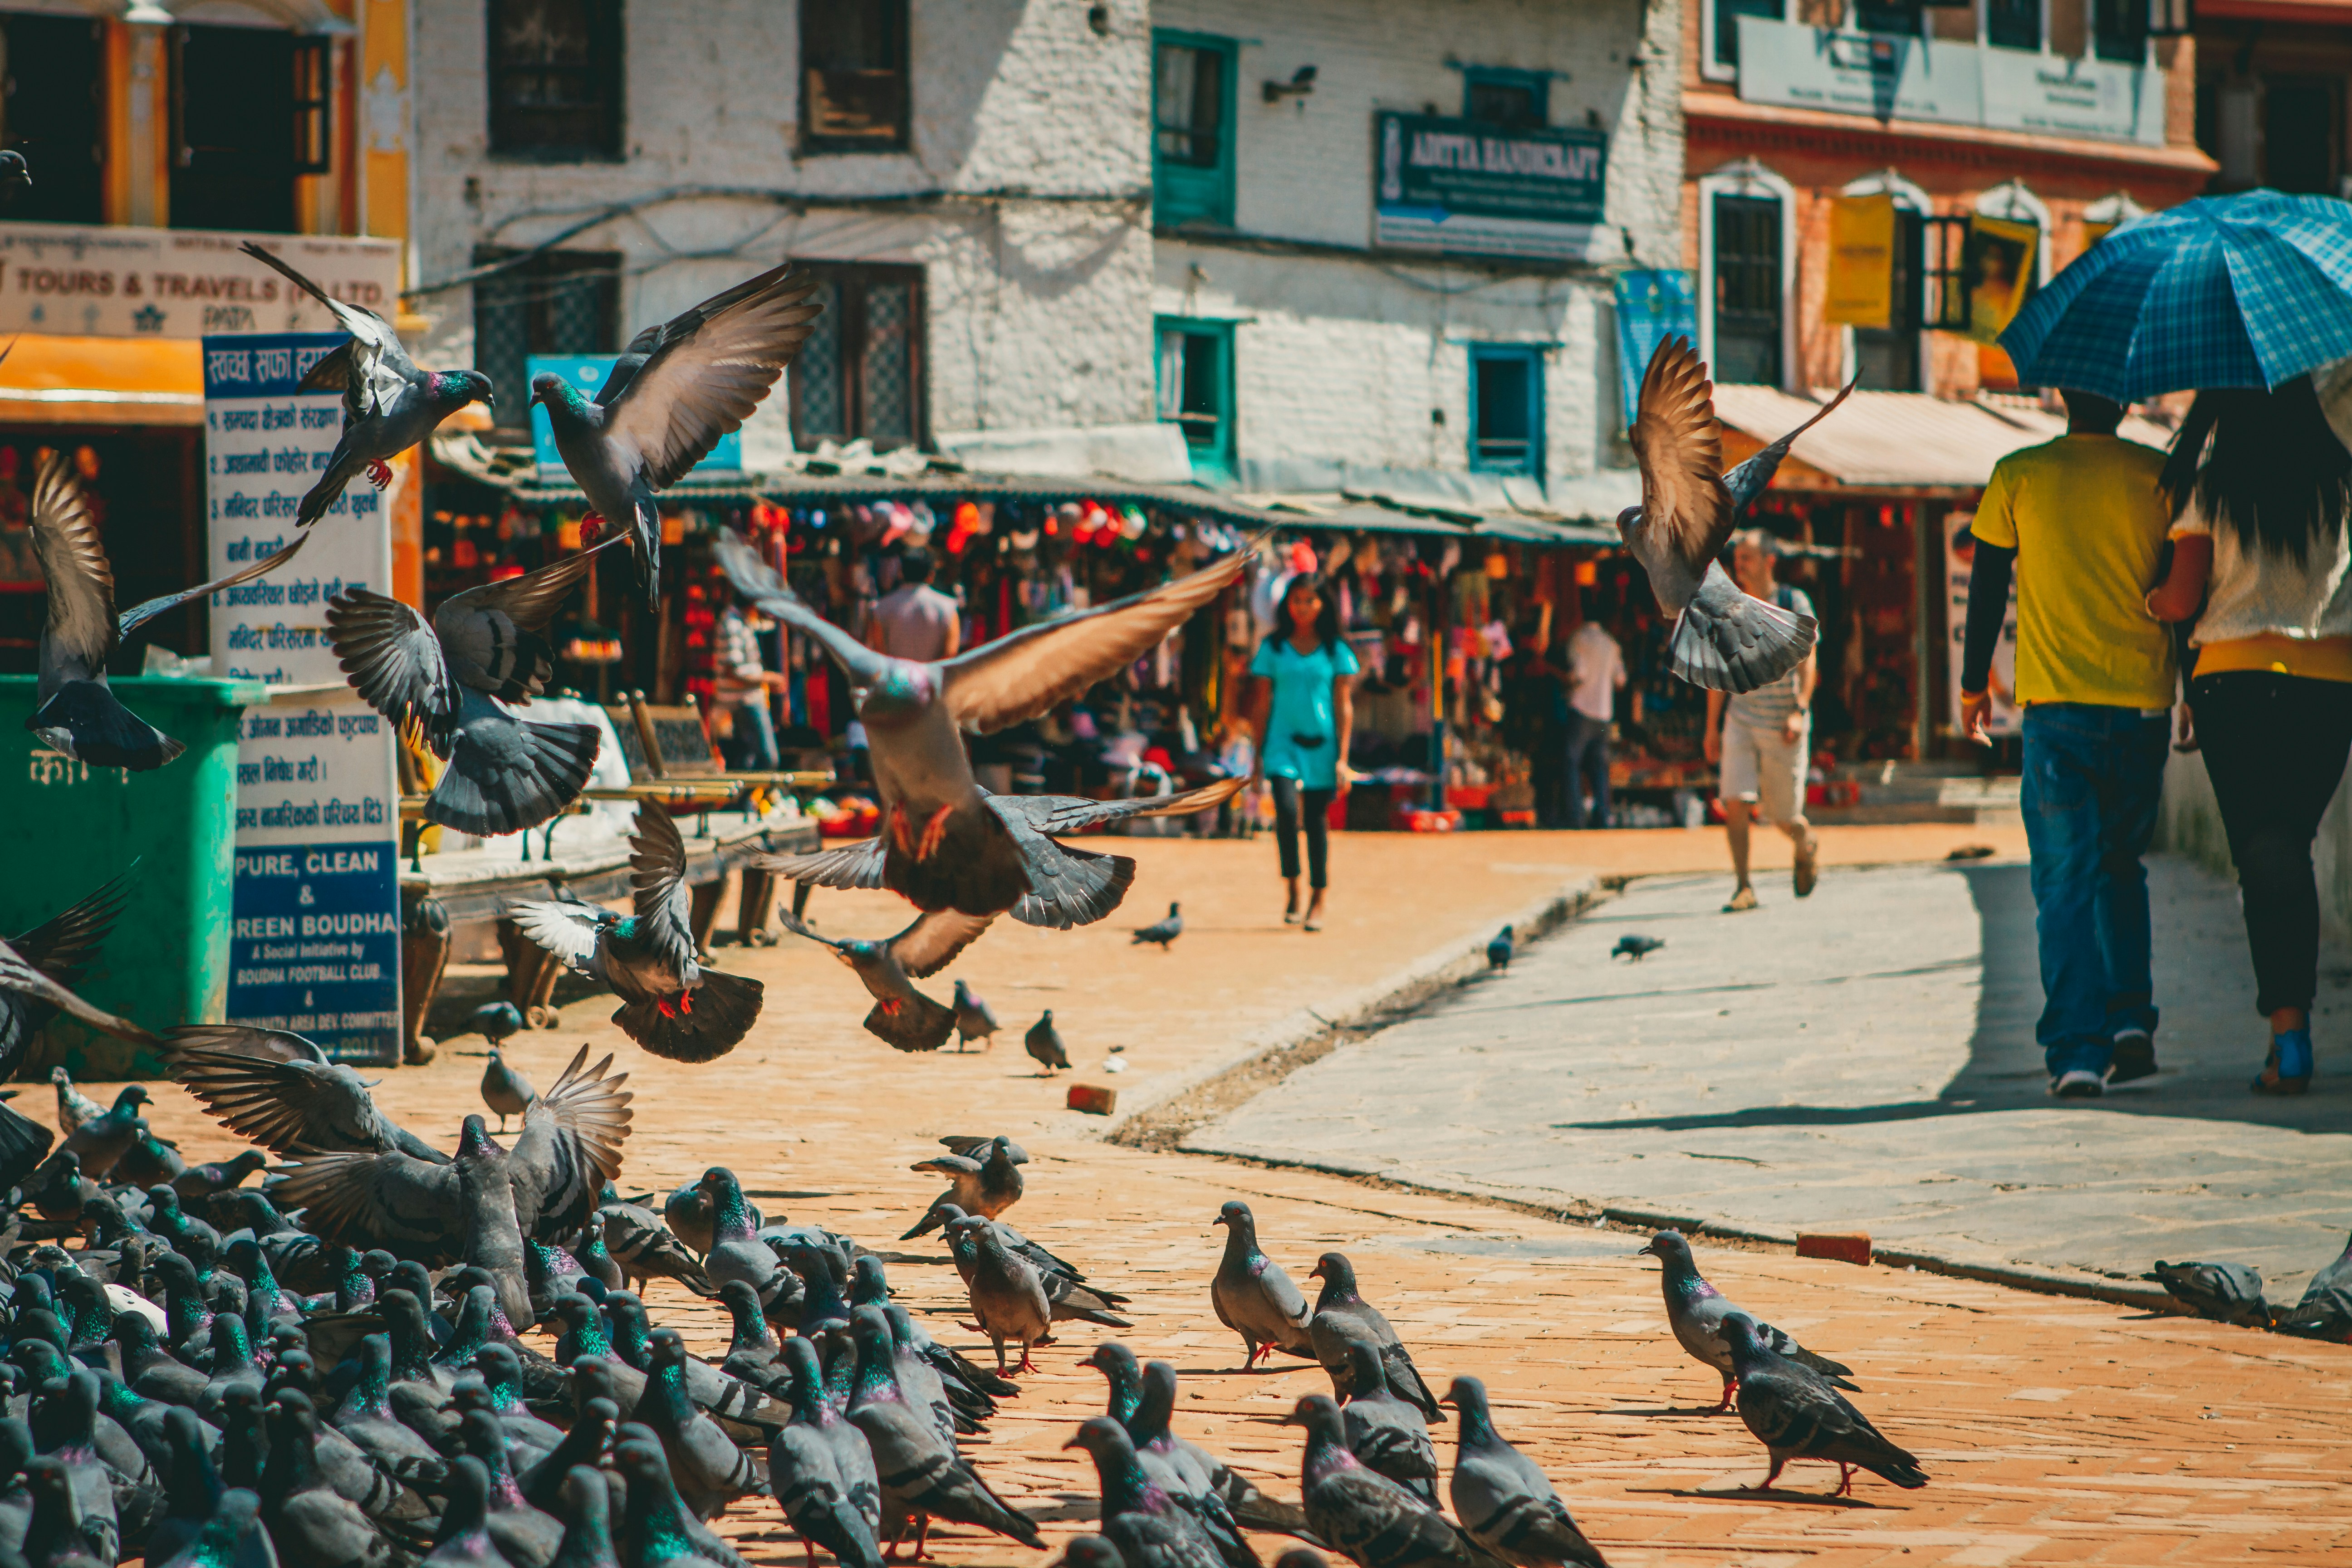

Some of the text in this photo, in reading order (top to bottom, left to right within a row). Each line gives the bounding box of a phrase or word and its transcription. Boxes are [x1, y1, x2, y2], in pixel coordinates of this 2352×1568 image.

[18, 266, 114, 296] TOURS
[123, 272, 143, 298] &
[154, 273, 279, 303] TRAVELS
[255, 348, 291, 383] सफा
[235, 851, 378, 879] PURE, CLEAN
[299, 885, 315, 905] &
[233, 913, 396, 939] REEN BOUDHA
[252, 940, 365, 960] A Social Initiative by
[237, 963, 380, 985] BOUDHA FOOTBALL CLUB
[305, 990, 314, 1007] &
